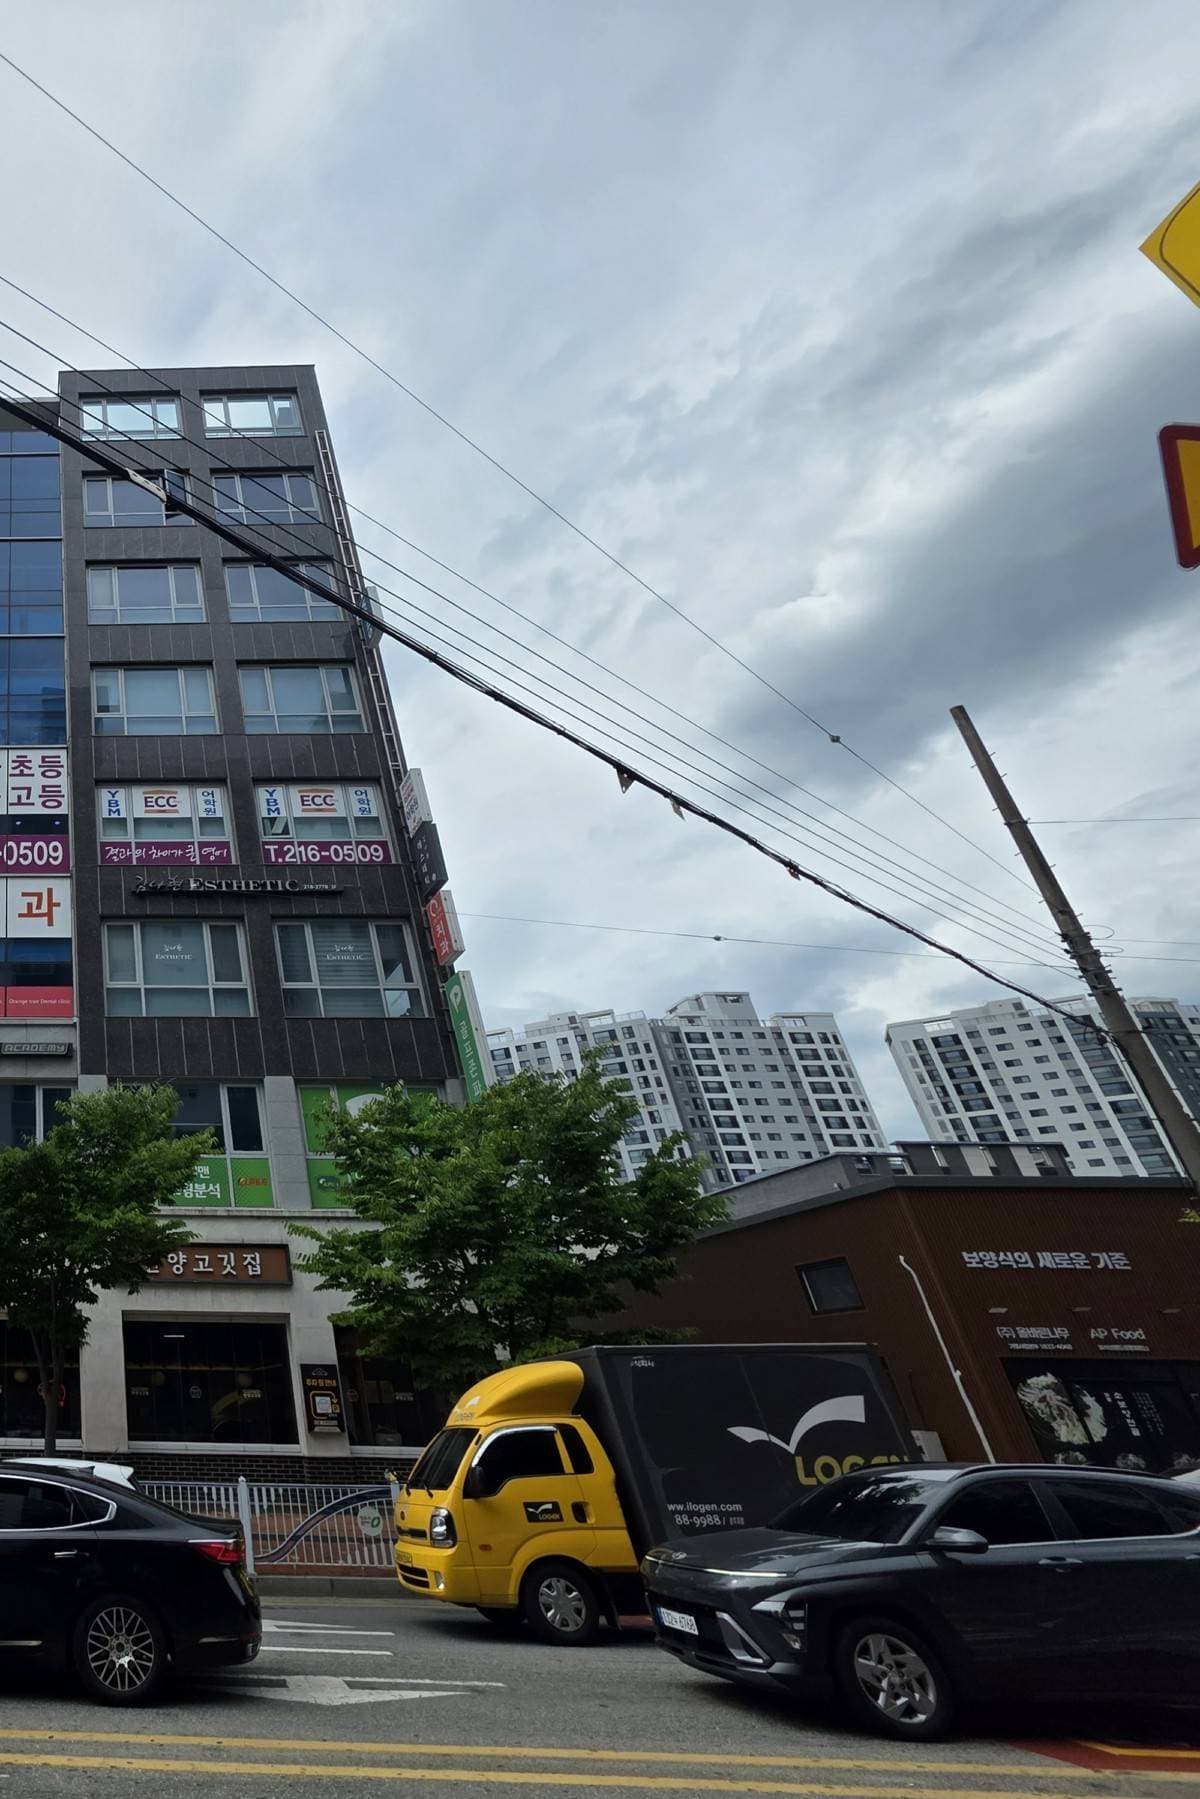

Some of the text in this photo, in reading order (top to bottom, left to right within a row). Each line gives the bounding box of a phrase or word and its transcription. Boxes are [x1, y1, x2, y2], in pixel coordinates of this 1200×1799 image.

[107, 790, 121, 816] YBM
[144, 795, 178, 808] ECC
[201, 790, 217, 816] 어학원
[265, 789, 281, 816] YBM
[300, 794, 336, 807] ECC
[354, 789, 372, 816] 어학원
[105, 846, 146, 862] 결과의
[149, 847, 183, 859] 차이가
[264, 844, 384, 863] T.216-0509
[961, 1251, 1132, 1270] 보양식의 새로운 기준
[1112, 1327, 1146, 1340] Food
